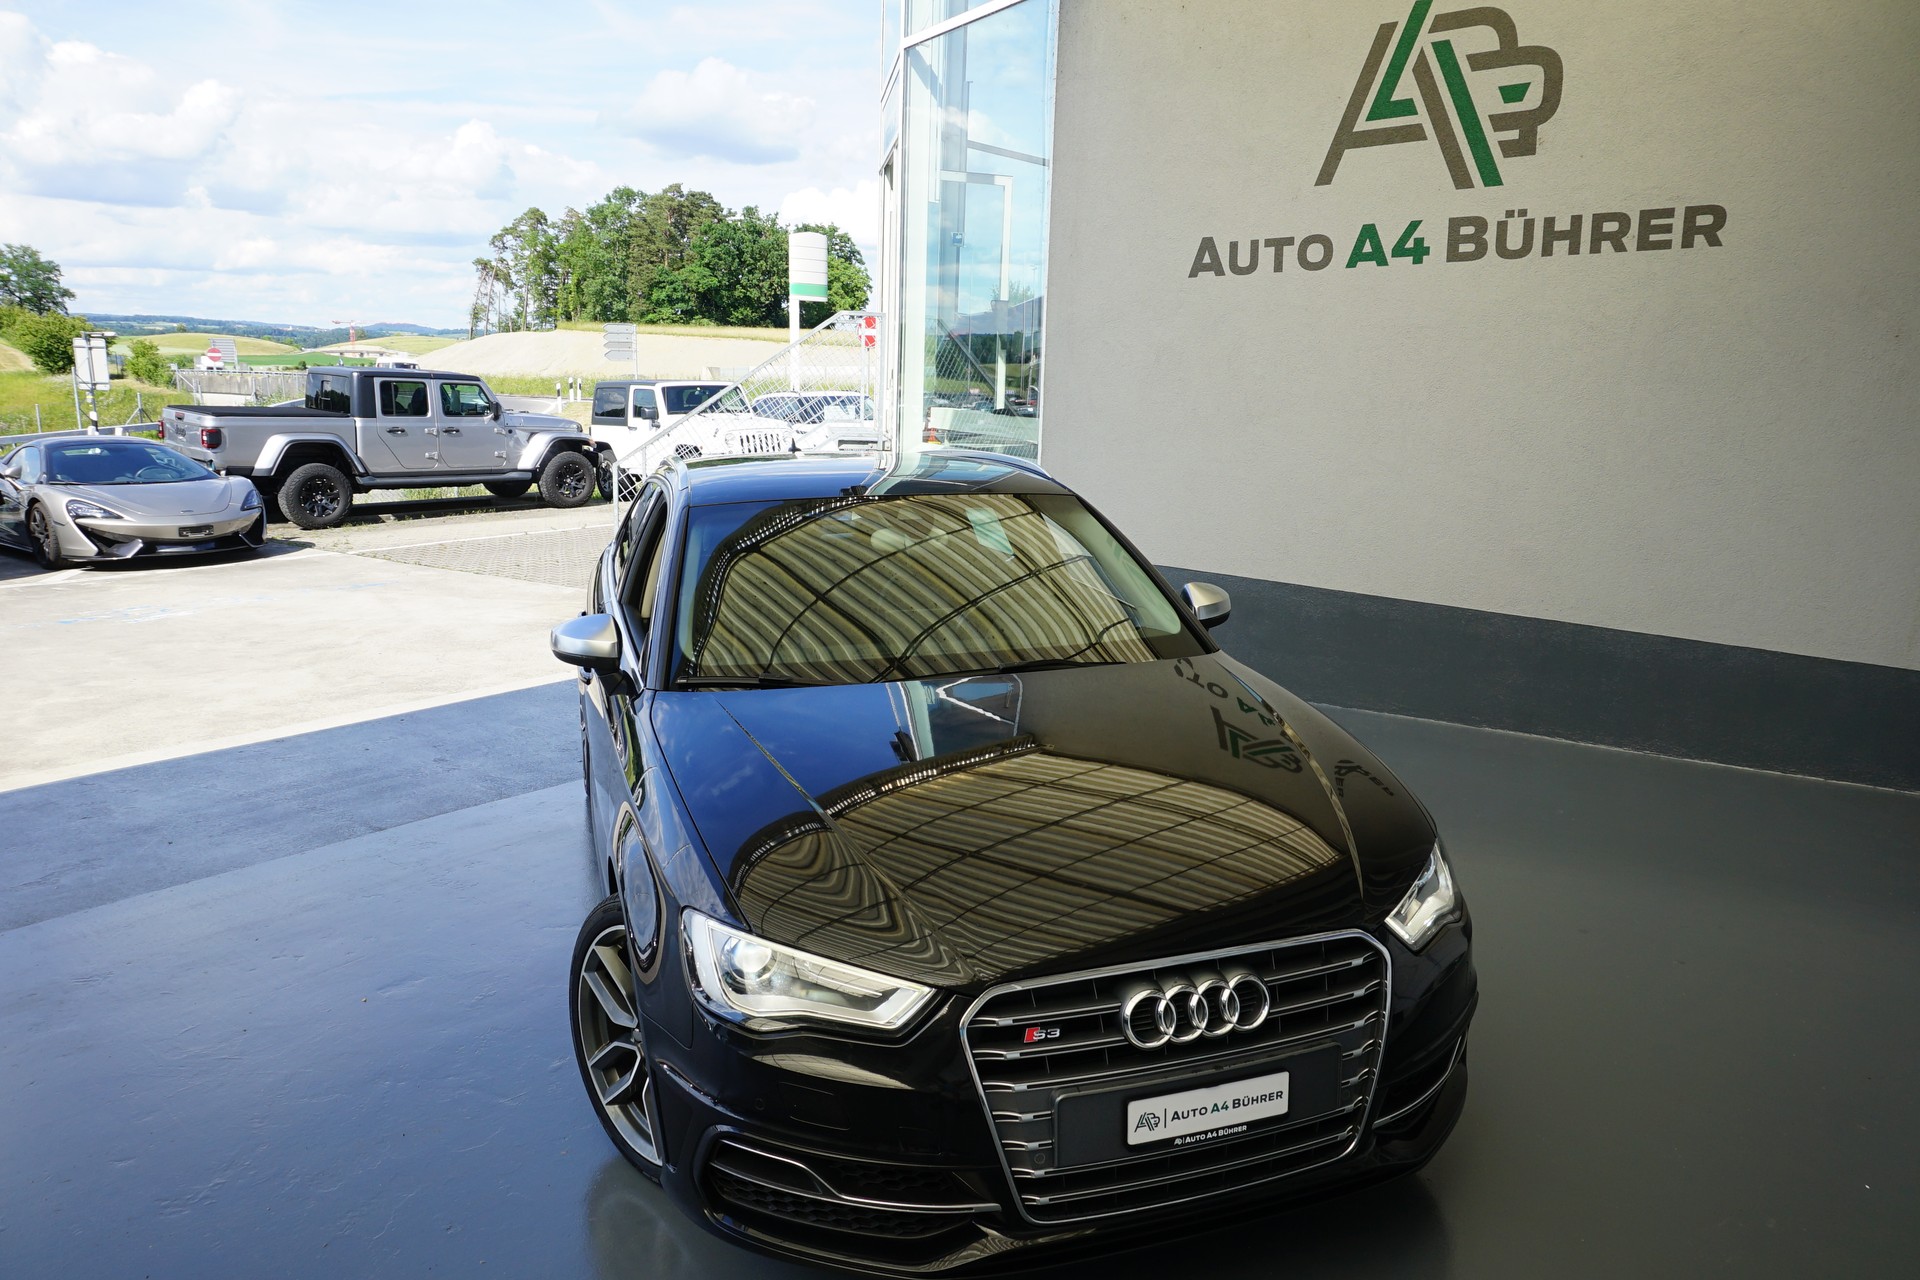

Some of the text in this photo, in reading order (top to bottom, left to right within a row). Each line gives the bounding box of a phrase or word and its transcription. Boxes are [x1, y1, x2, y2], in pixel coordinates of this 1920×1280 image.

[1188, 203, 1728, 279] AUTO A4 BÜHRER
[1030, 1027, 1061, 1041] S3
[1171, 1106, 1208, 1122] AUTO
[1210, 1100, 1230, 1114] A4
[1232, 1090, 1284, 1109] BÜHRER
[1185, 1133, 1206, 1144] AUTO
[1206, 1130, 1218, 1139] A4
